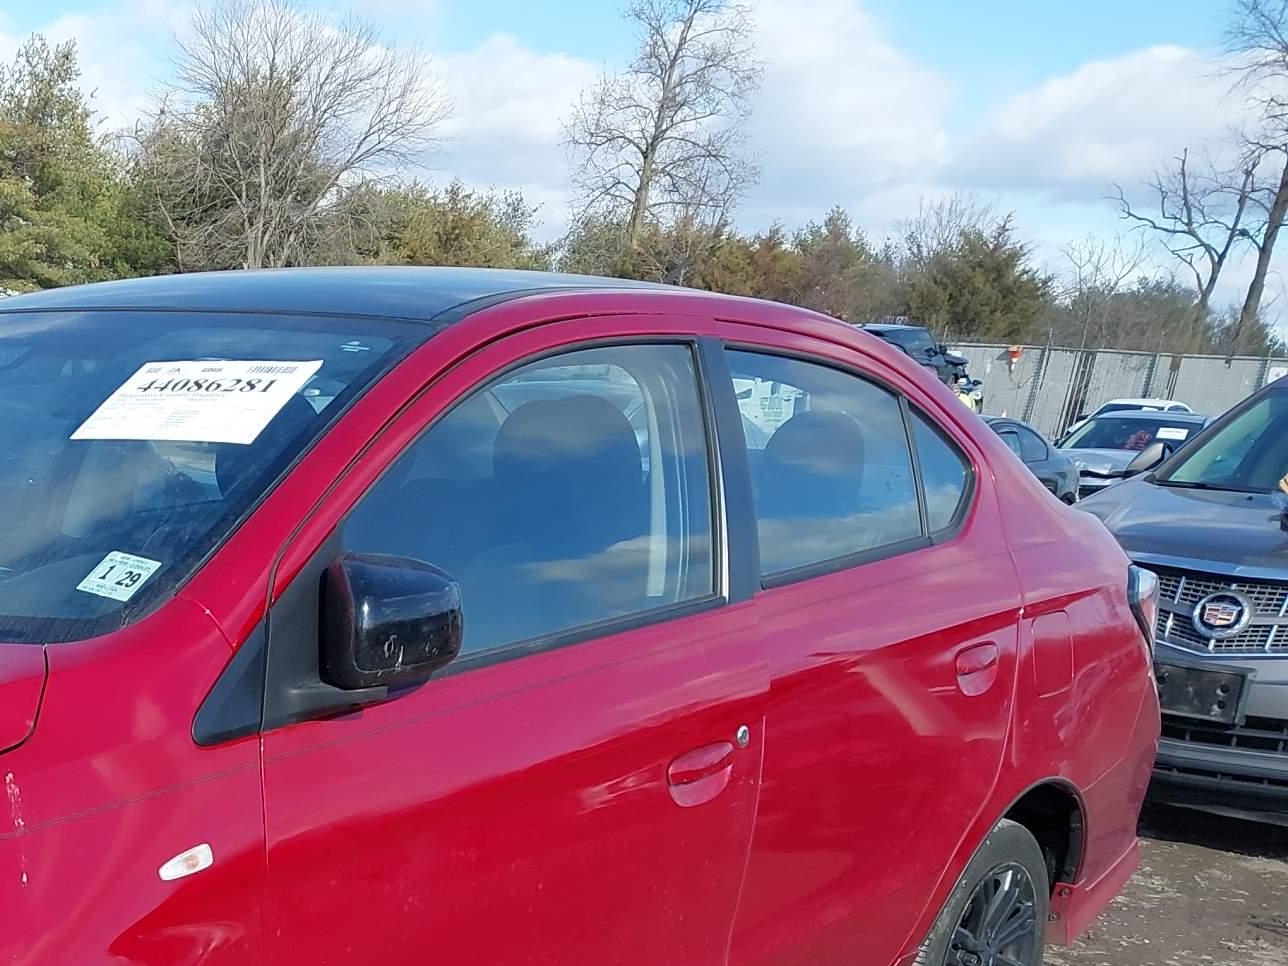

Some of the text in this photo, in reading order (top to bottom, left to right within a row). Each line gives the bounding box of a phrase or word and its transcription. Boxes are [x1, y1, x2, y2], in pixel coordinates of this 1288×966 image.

[136, 377, 278, 393] 44086281
[98, 564, 117, 580] 1
[114, 570, 142, 588] 29
